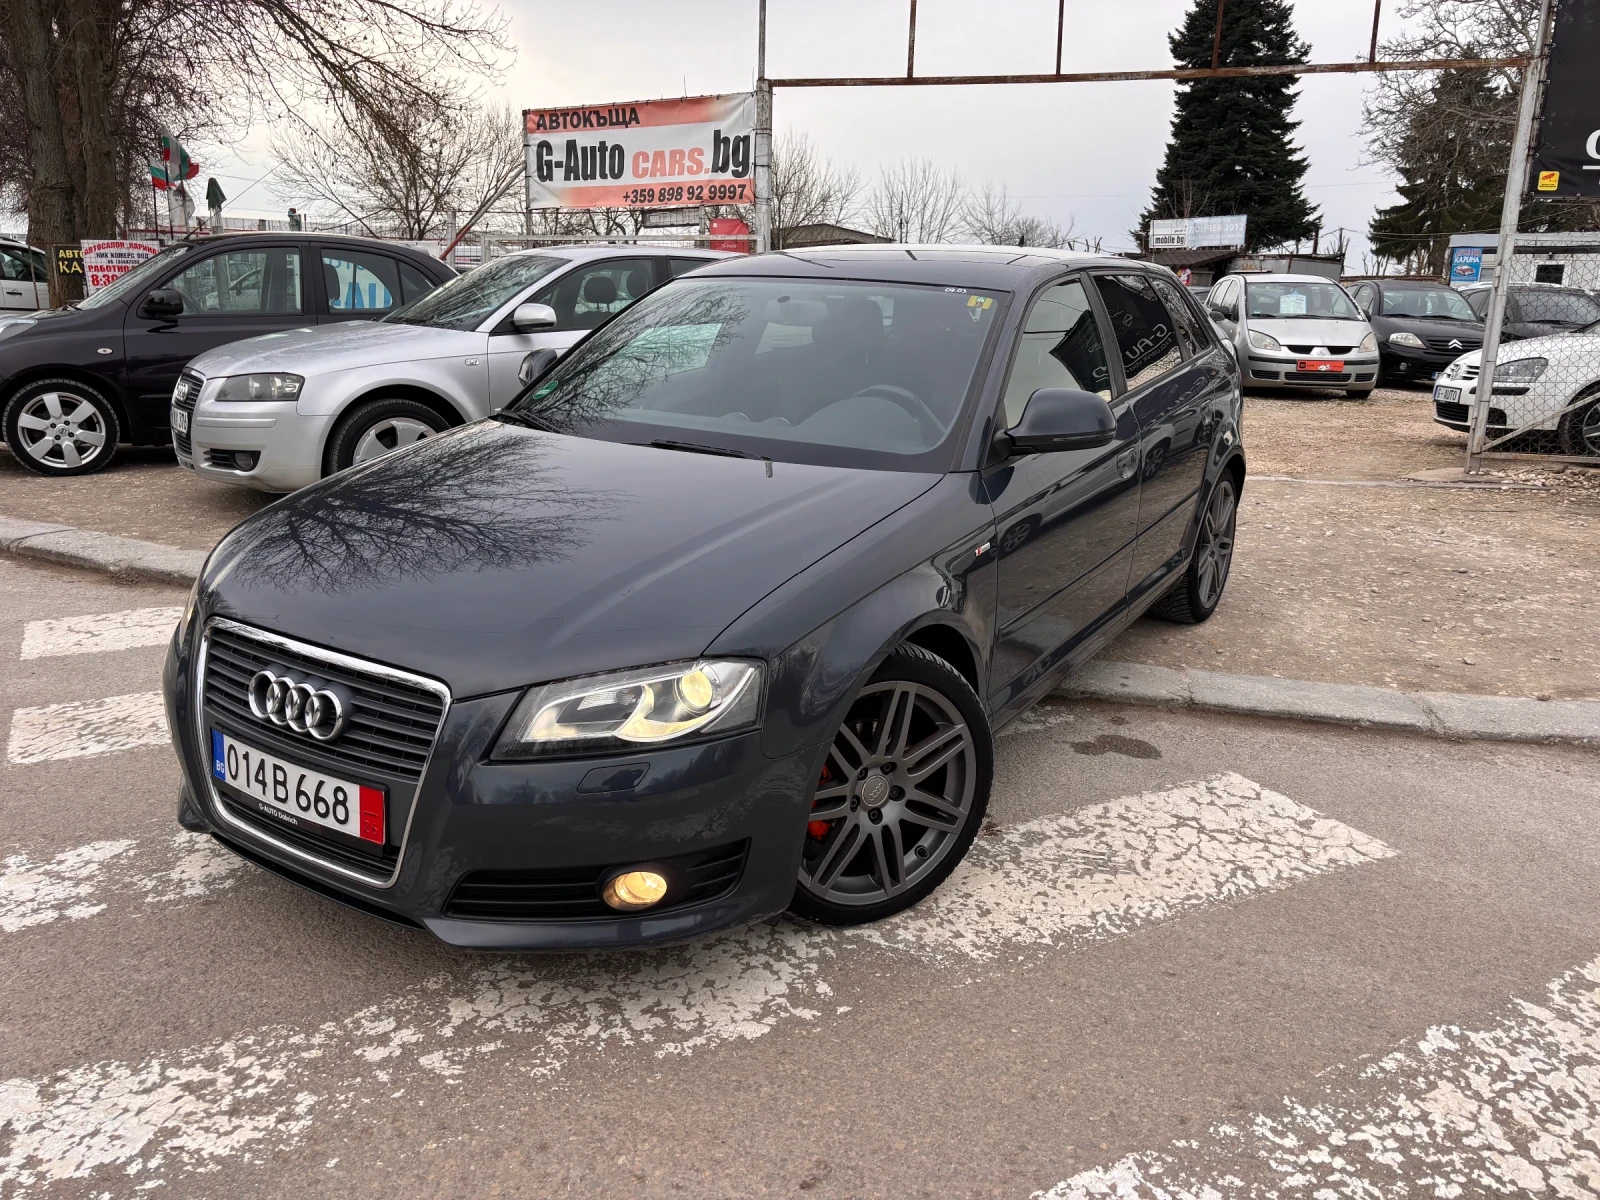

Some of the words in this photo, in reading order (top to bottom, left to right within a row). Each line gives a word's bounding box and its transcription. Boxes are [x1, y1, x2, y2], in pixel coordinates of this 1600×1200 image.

[536, 107, 640, 131] АВТОКЪЩА
[535, 139, 625, 182] G-Auto
[622, 188, 654, 204] +359
[658, 186, 683, 203] 898
[687, 185, 704, 201] 92
[708, 184, 747, 201] 9997
[1224, 223, 1244, 232] 2012
[84, 241, 125, 256] АВТОСАЛОН
[136, 252, 149, 260] ООД
[58, 260, 85, 274] КА
[88, 265, 130, 273] РАБОТНО
[215, 759, 225, 774] BG
[278, 811, 298, 825] Dobrich
